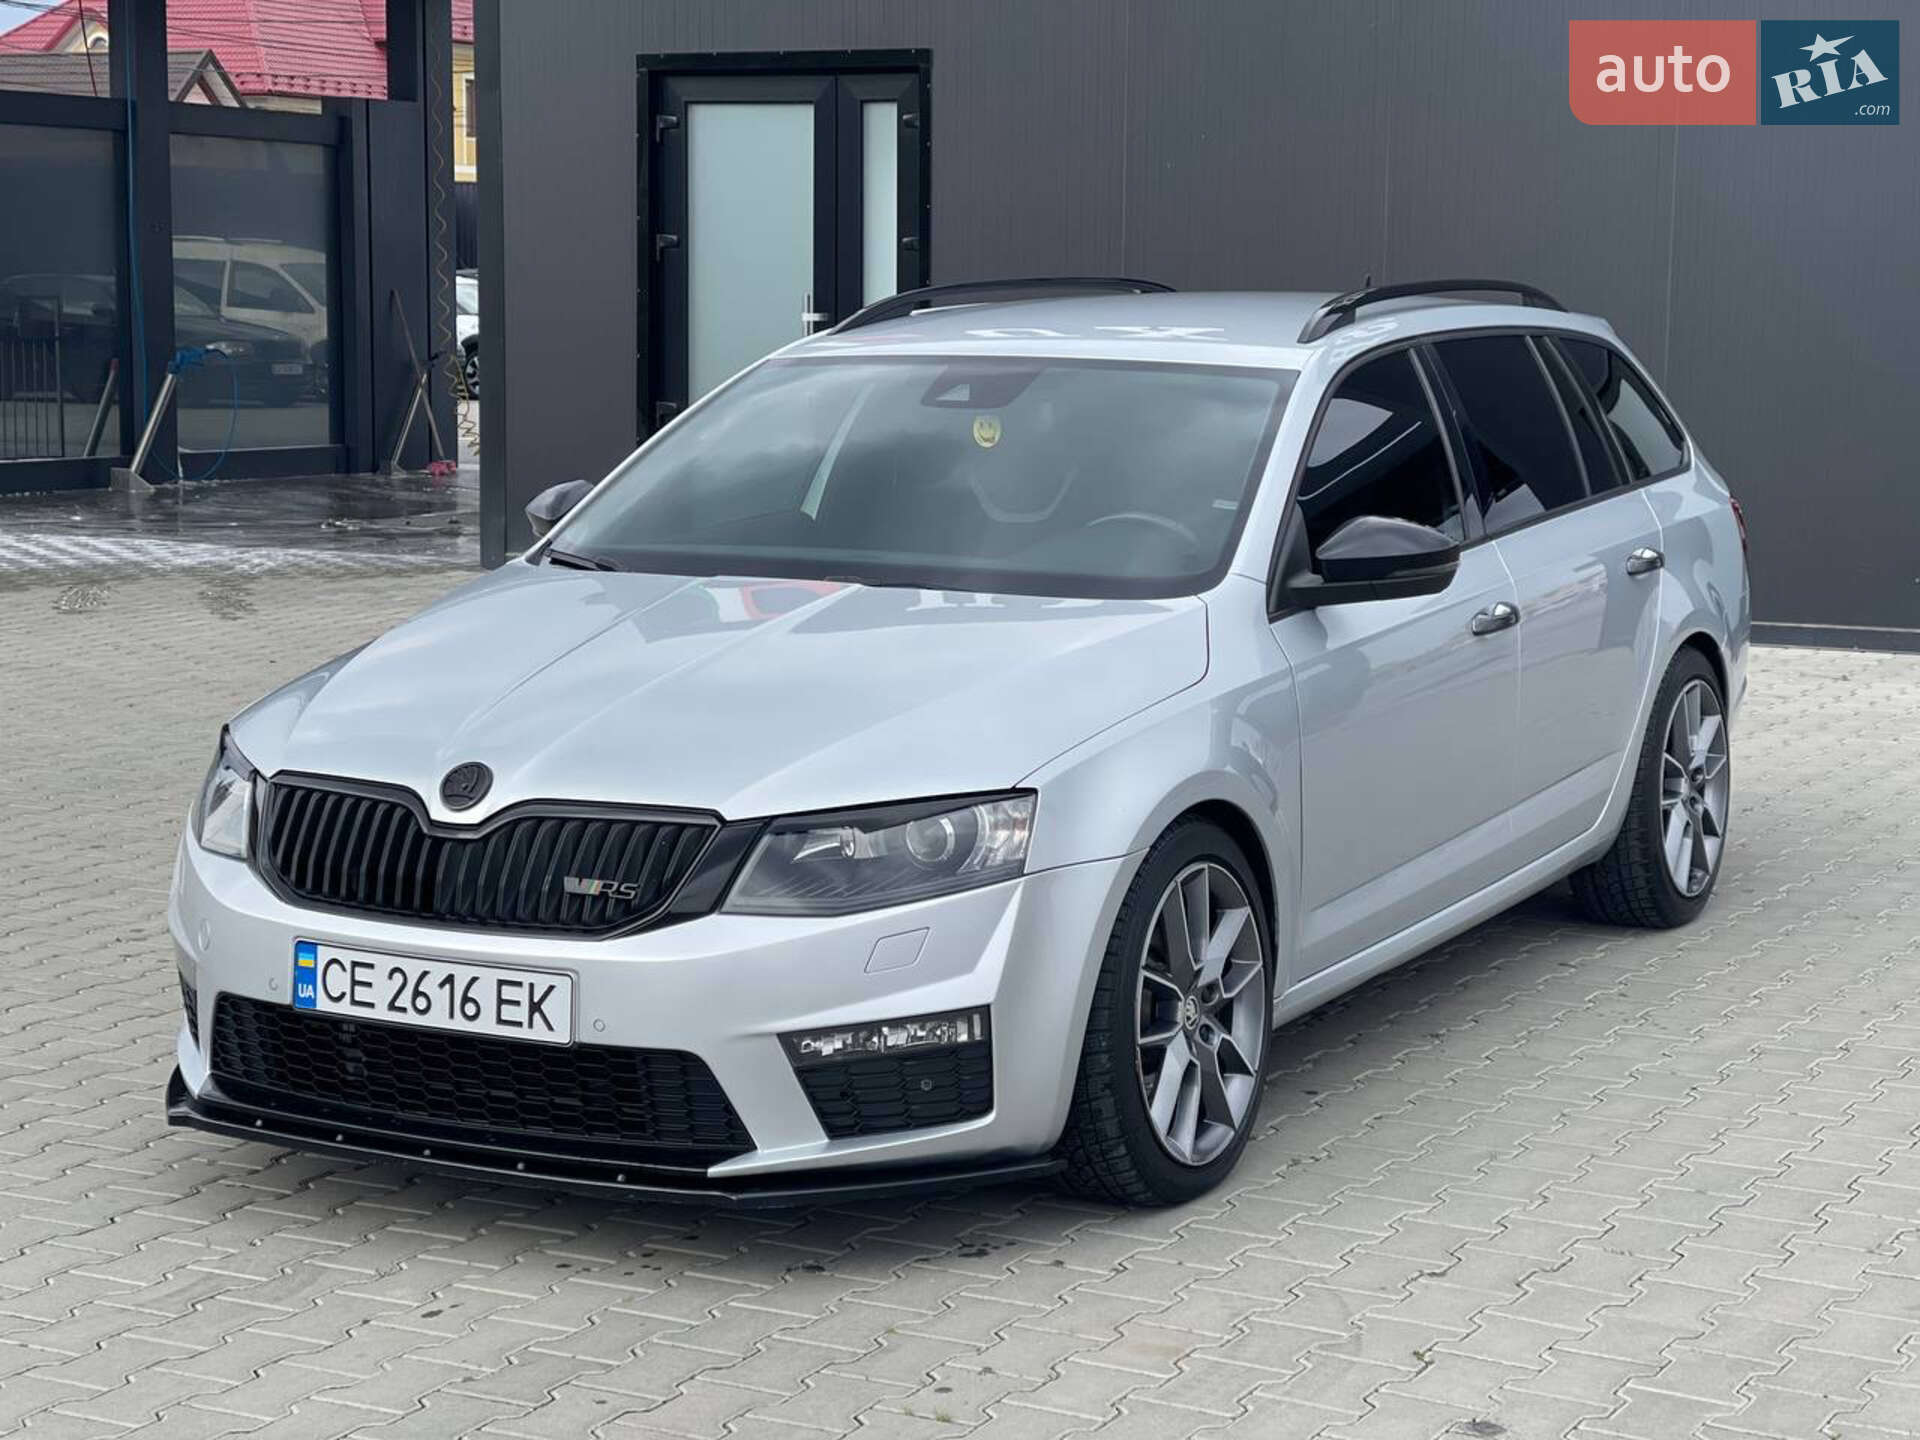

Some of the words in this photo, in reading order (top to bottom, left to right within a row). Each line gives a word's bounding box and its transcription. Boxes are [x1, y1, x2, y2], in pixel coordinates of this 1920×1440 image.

[298, 983, 315, 999] UA
[321, 957, 376, 1009] CE
[386, 966, 482, 1022] 2616
[495, 978, 557, 1032] EK
